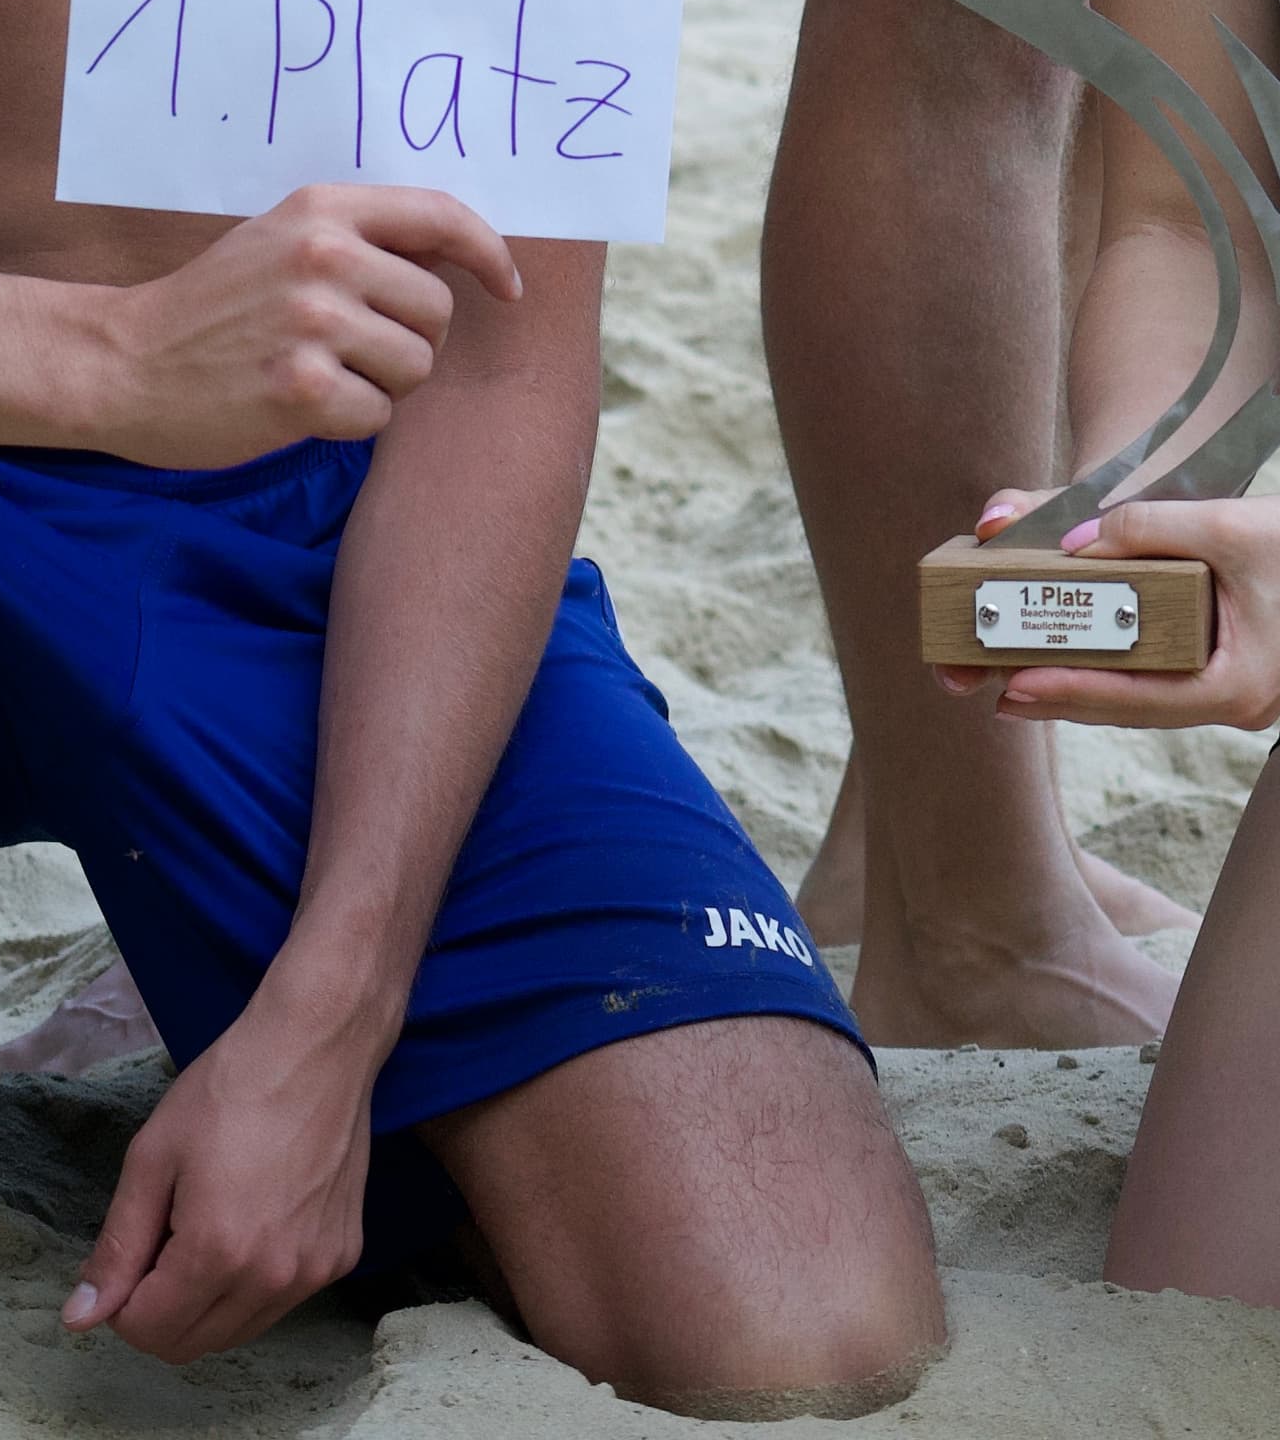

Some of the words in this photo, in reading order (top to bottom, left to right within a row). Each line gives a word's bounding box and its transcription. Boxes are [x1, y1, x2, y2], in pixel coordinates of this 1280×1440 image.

[1041, 586, 1094, 607] Platz
[1020, 608, 1093, 620] Beachvolleyball
[1021, 621, 1092, 631] Blaulichtturnier
[1046, 635, 1068, 644] 2025
[704, 907, 813, 967] JAKO
